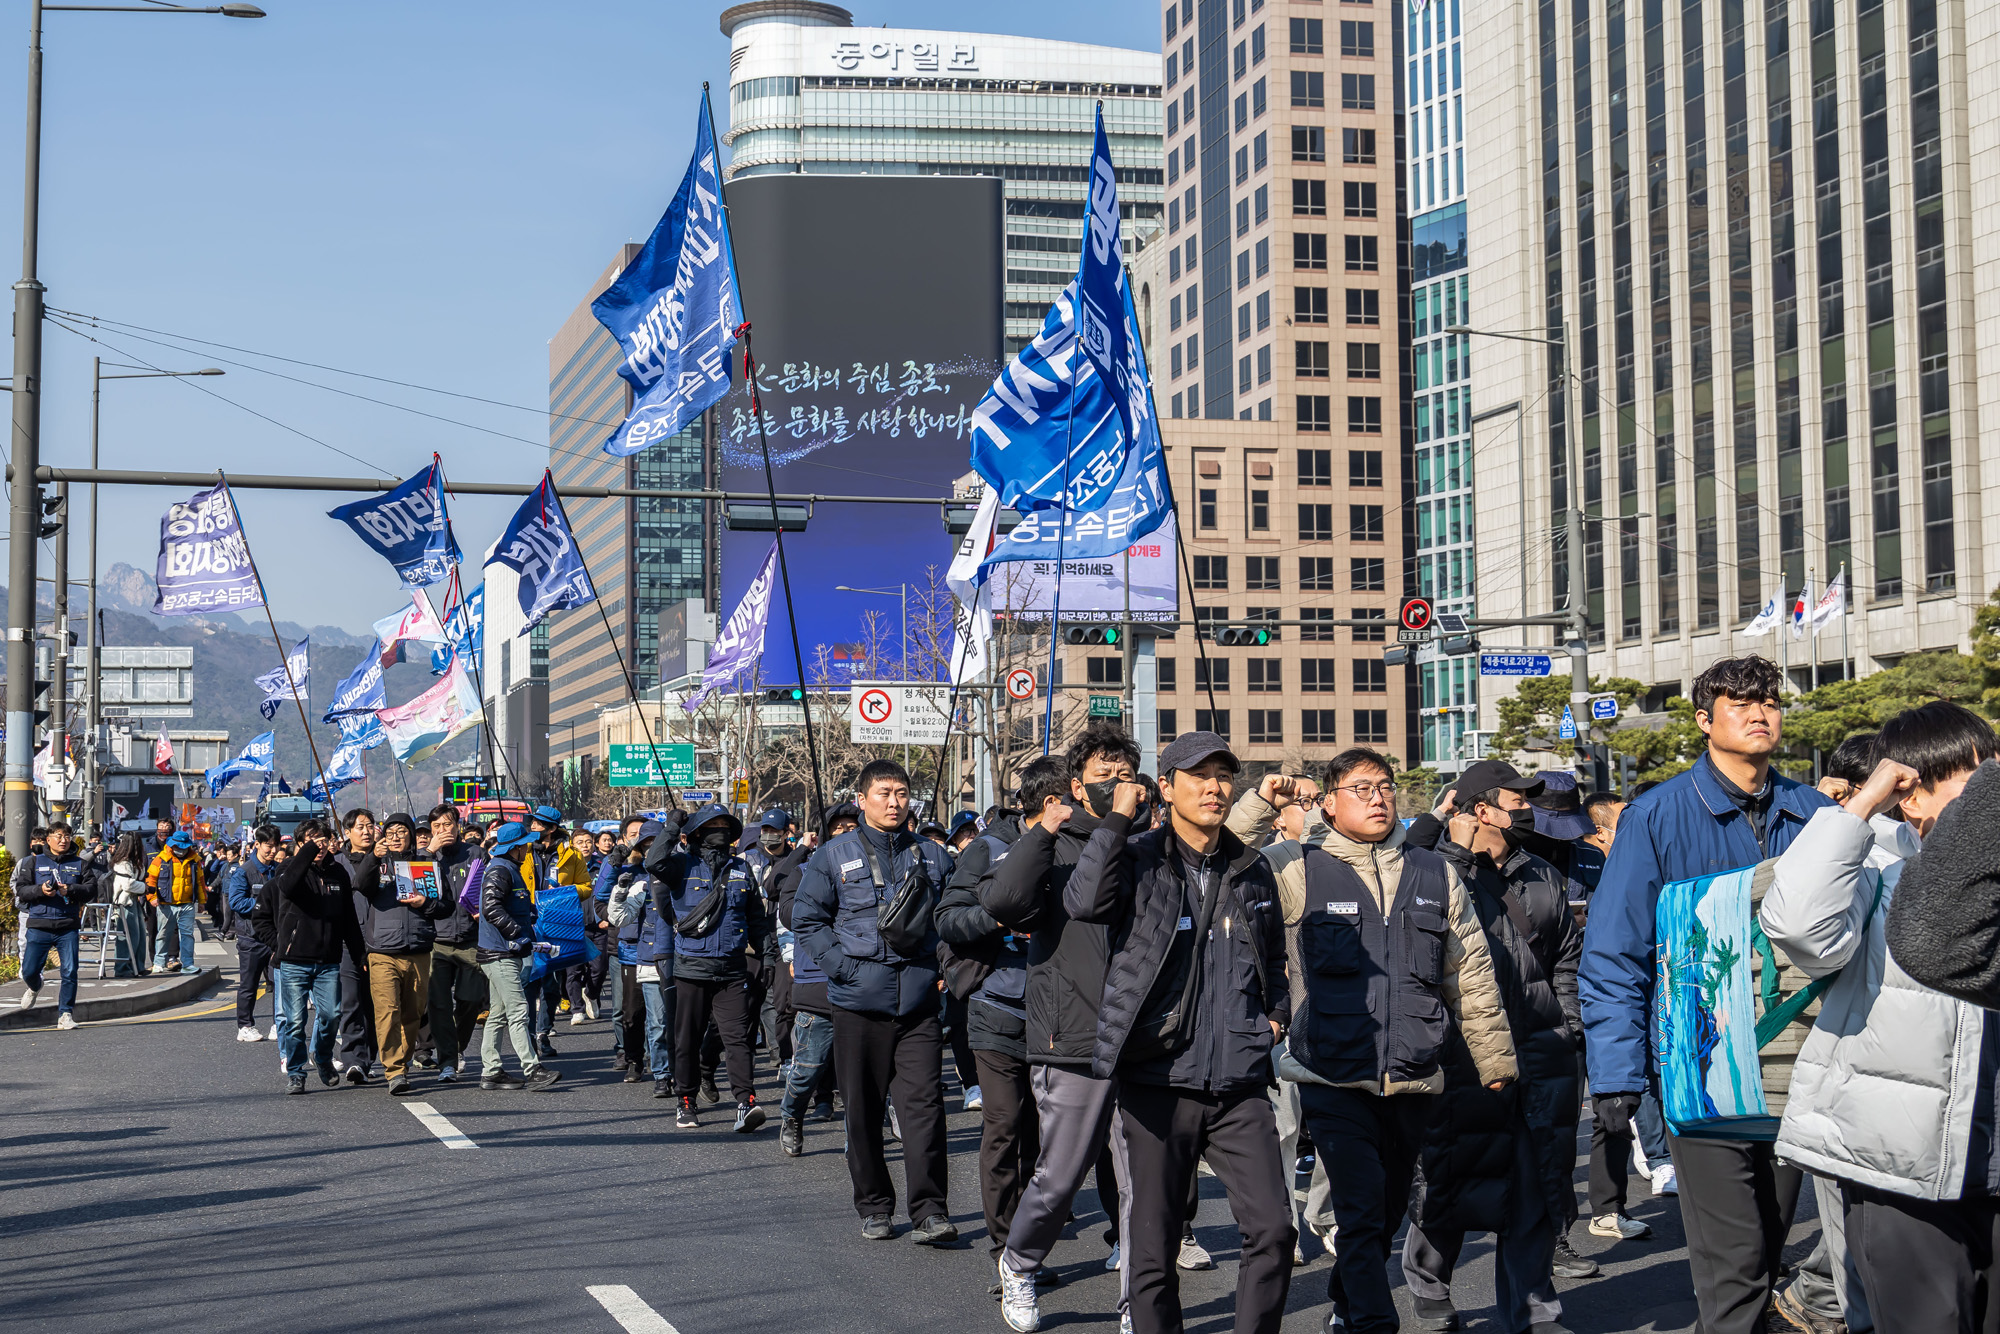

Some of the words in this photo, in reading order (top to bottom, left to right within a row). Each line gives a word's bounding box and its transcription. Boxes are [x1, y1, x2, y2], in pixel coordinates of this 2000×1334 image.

[831, 41, 980, 71] 동아일보
[746, 360, 840, 396] K-문화의
[847, 362, 895, 395] 중심
[899, 360, 951, 397] 종로,
[730, 407, 781, 444] 종로는
[784, 404, 856, 444] 문화를
[1033, 563, 1050, 576] 꼭!
[1053, 563, 1114, 576] 기억하세요
[1400, 631, 1429, 640] 일방통행
[1483, 656, 1534, 667] 세종대로20길
[1482, 667, 1522, 675] Sejong-daero
[1524, 667, 1542, 675] 20-gil
[904, 688, 946, 699] 청계천로
[859, 727, 892, 736] 전방200m
[423, 870, 438, 899] 하자!
